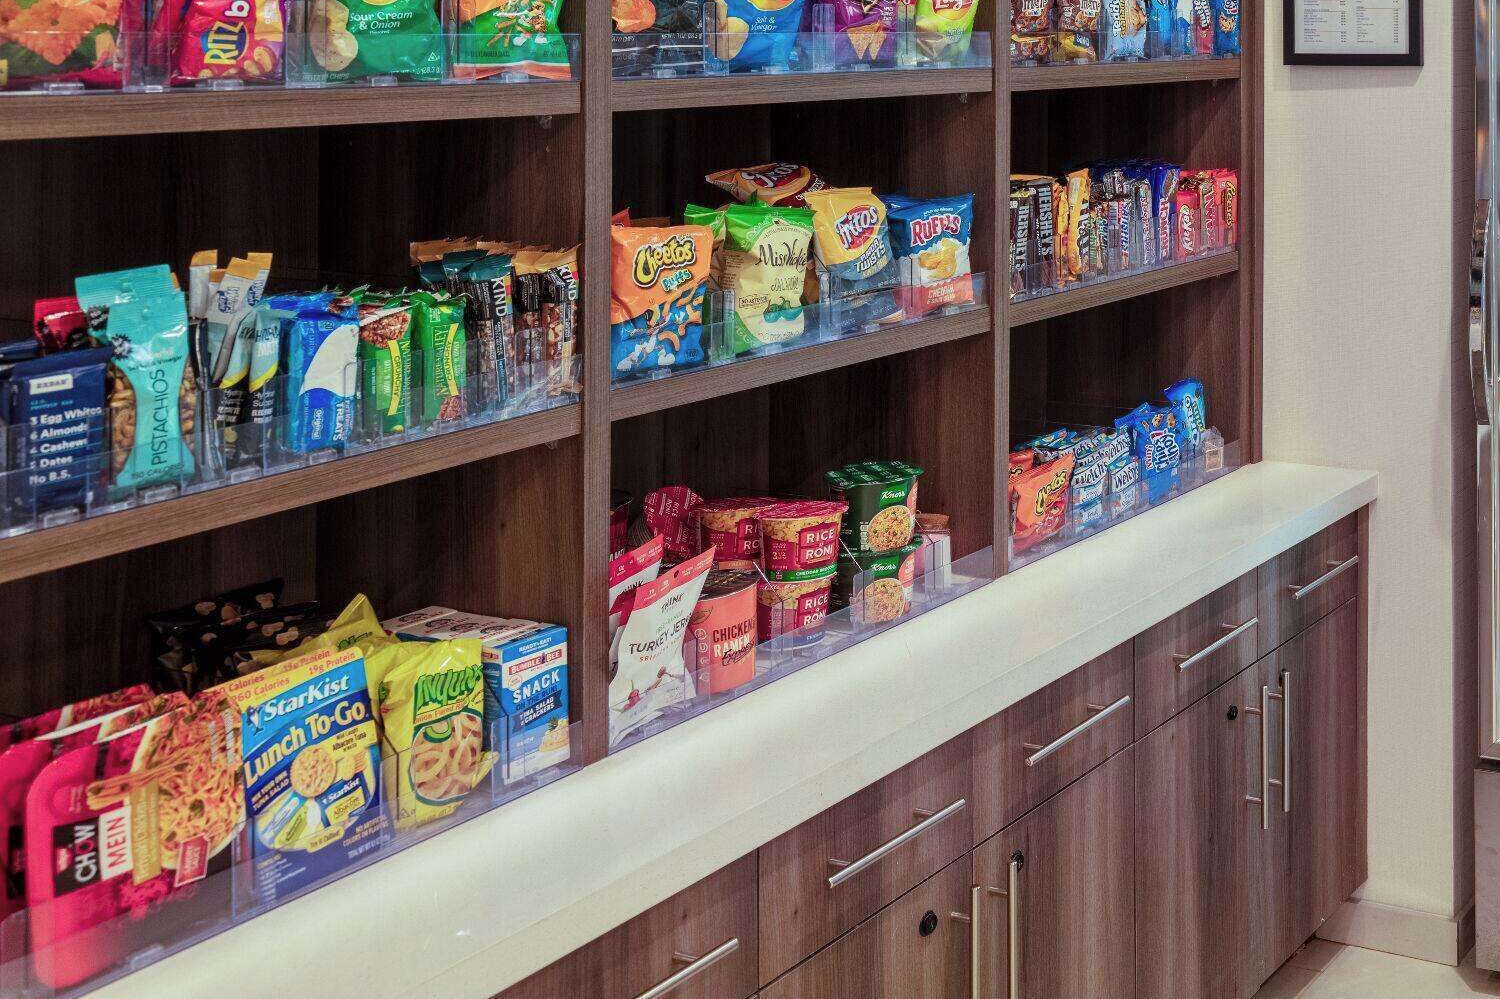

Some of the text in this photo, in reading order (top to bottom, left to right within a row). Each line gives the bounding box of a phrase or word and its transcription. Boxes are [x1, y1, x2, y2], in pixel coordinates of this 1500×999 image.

[350, 10, 413, 22] Sour Cream
[370, 20, 400, 31] Onion
[754, 15, 767, 25] Salt
[203, 19, 245, 65] RITZ
[835, 205, 879, 249] Fritos
[633, 234, 697, 288] Cheetos
[854, 246, 886, 273] TWISTS
[558, 263, 578, 301] KIND
[492, 278, 507, 317] KIND
[445, 340, 453, 382] CRUNCHY
[392, 355, 401, 401] CRUNCHY
[40, 405, 102, 425] Egg Whites
[150, 368, 169, 467] PISTACHIOS
[333, 401, 345, 441] TREATS
[40, 422, 89, 440] Almonds
[40, 438, 88, 455] Cashews
[40, 455, 73, 468] Dates
[29, 470, 71, 486] No B.S.
[880, 489, 906, 500] Knorr
[805, 528, 836, 545] RICE
[805, 545, 835, 561] RONI
[870, 562, 897, 572] Knorr
[804, 593, 829, 610] RICE
[712, 617, 757, 643] CHICKEN
[802, 610, 828, 628] RONI
[627, 630, 671, 656] TURKEY
[713, 638, 751, 658] RAMEN
[299, 649, 331, 666] Protein
[308, 651, 356, 676] 19g Protein
[510, 650, 562, 674] BUMBLE BEE
[254, 675, 291, 695] Calories
[512, 669, 561, 704] SNACK
[263, 673, 350, 723] StarKist
[534, 696, 555, 712] SALAD
[525, 703, 556, 725] CRACKERS
[243, 700, 367, 786] Lunch To-Go
[73, 824, 97, 883] CHOW
[105, 815, 128, 870] MEIN
